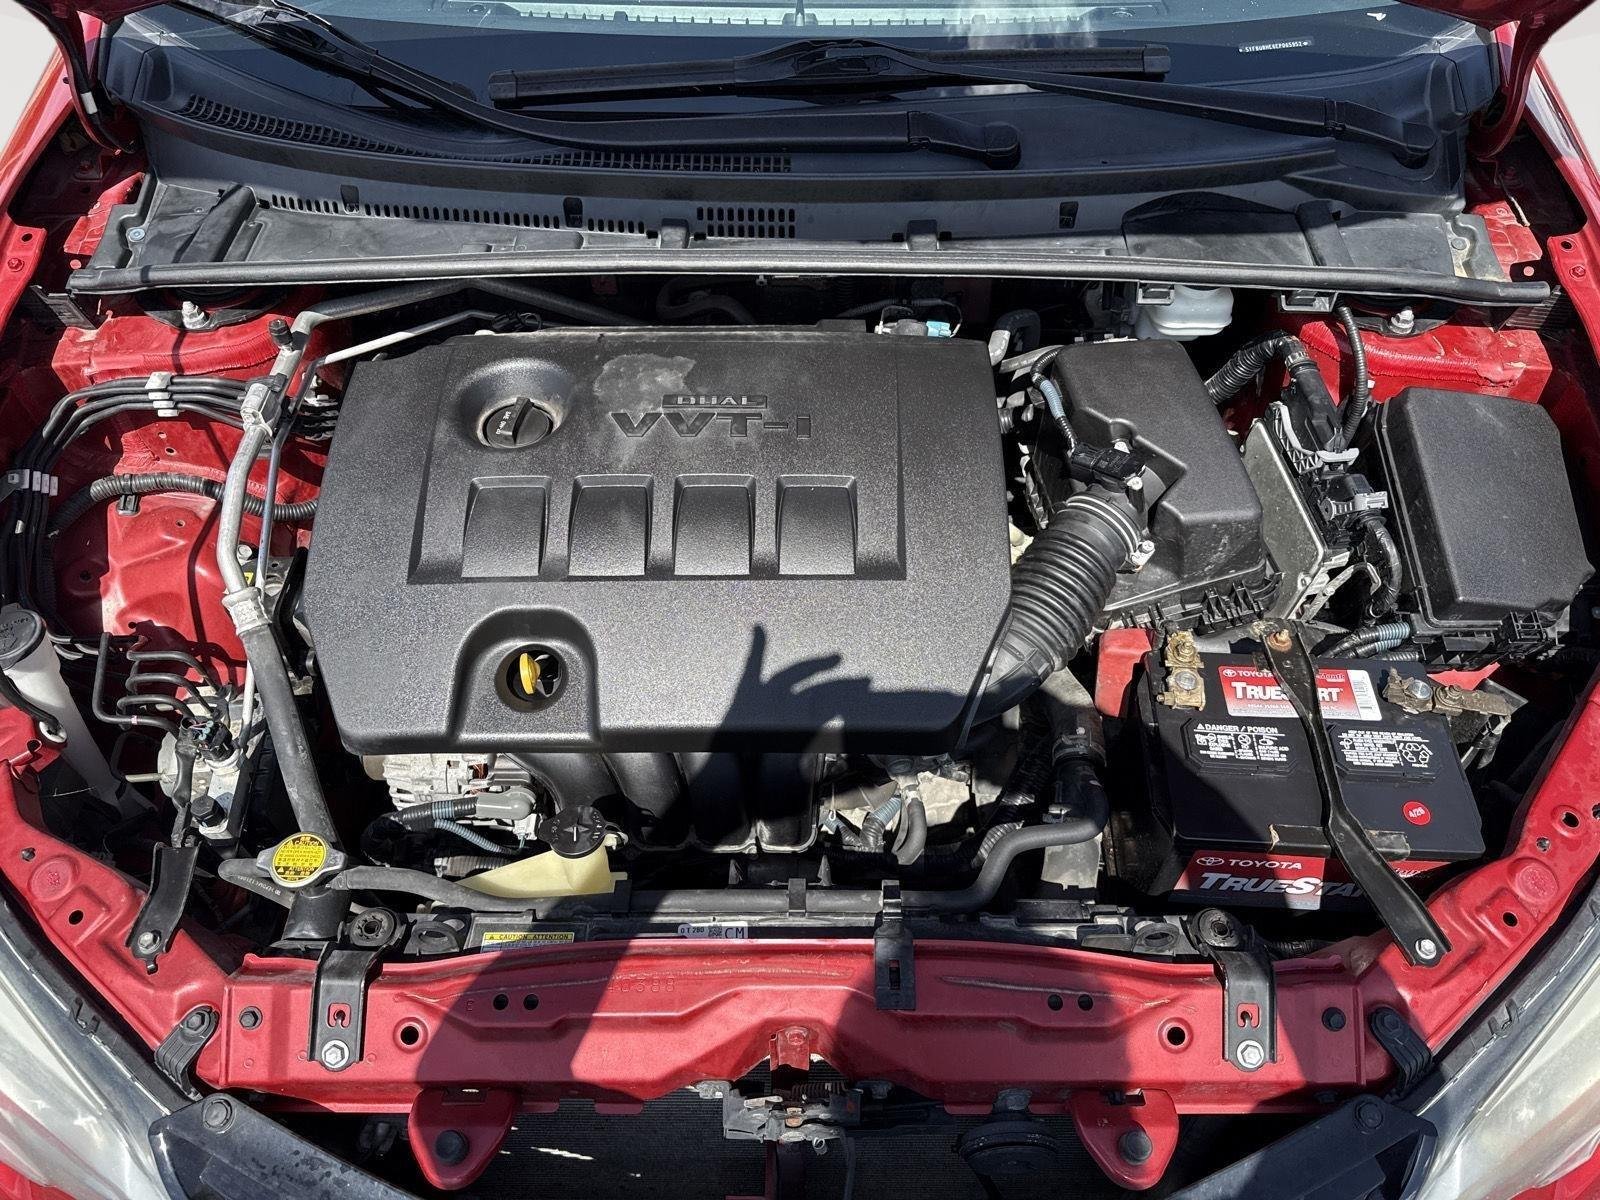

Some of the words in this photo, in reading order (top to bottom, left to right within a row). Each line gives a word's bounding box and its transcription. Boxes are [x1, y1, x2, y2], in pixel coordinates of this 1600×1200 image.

[677, 395, 758, 405] DUAL
[1205, 723, 1239, 732] DANGER
[1247, 726, 1278, 734] POISON
[1229, 859, 1302, 870] TOYOTA
[724, 927, 745, 939] CM
